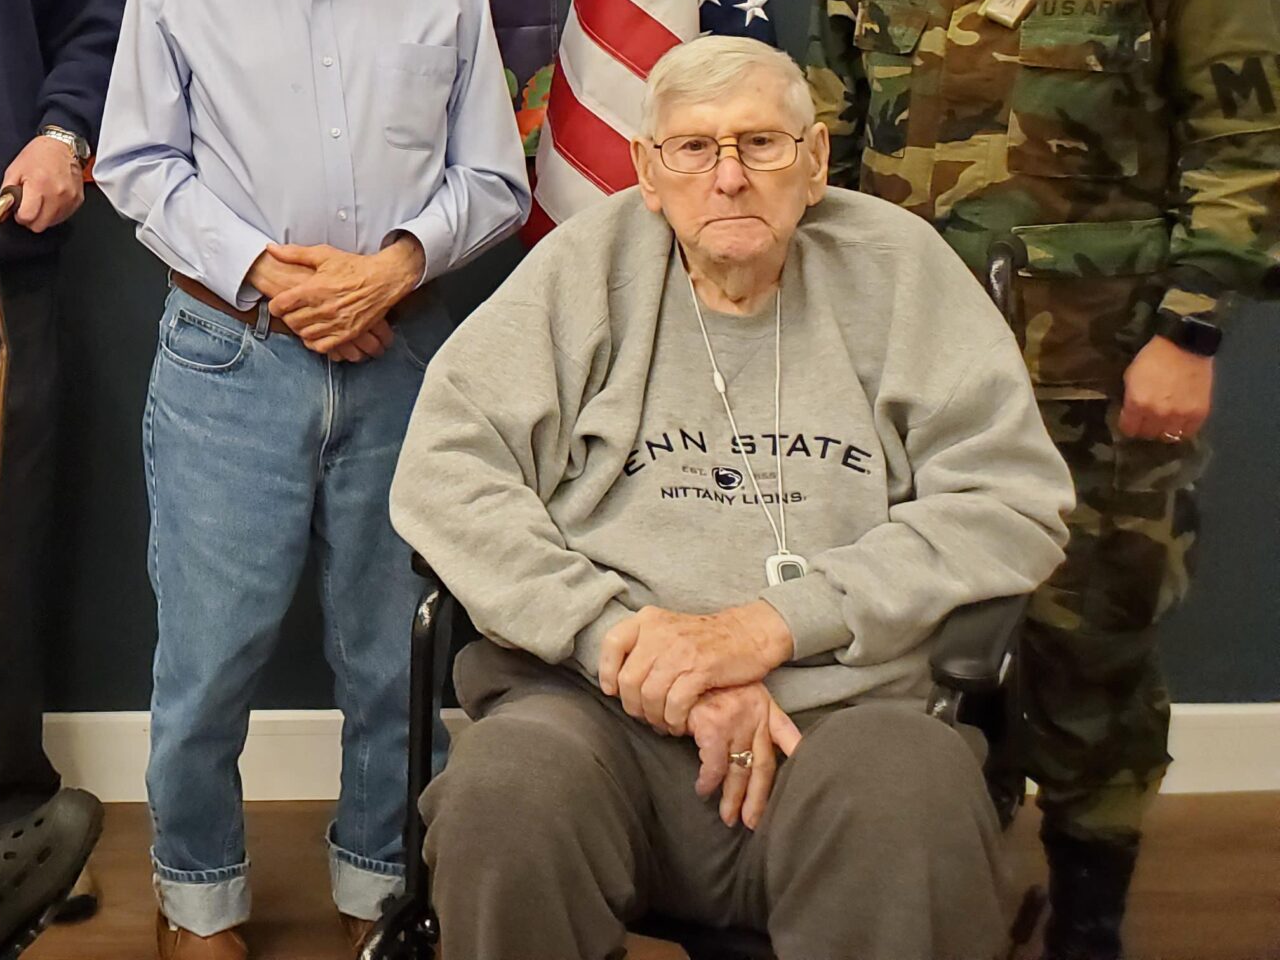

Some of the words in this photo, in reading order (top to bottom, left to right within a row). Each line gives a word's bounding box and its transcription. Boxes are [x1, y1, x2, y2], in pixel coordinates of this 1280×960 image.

[623, 428, 707, 477] ENN
[730, 433, 873, 474] STATE
[660, 486, 736, 506] NITTANY
